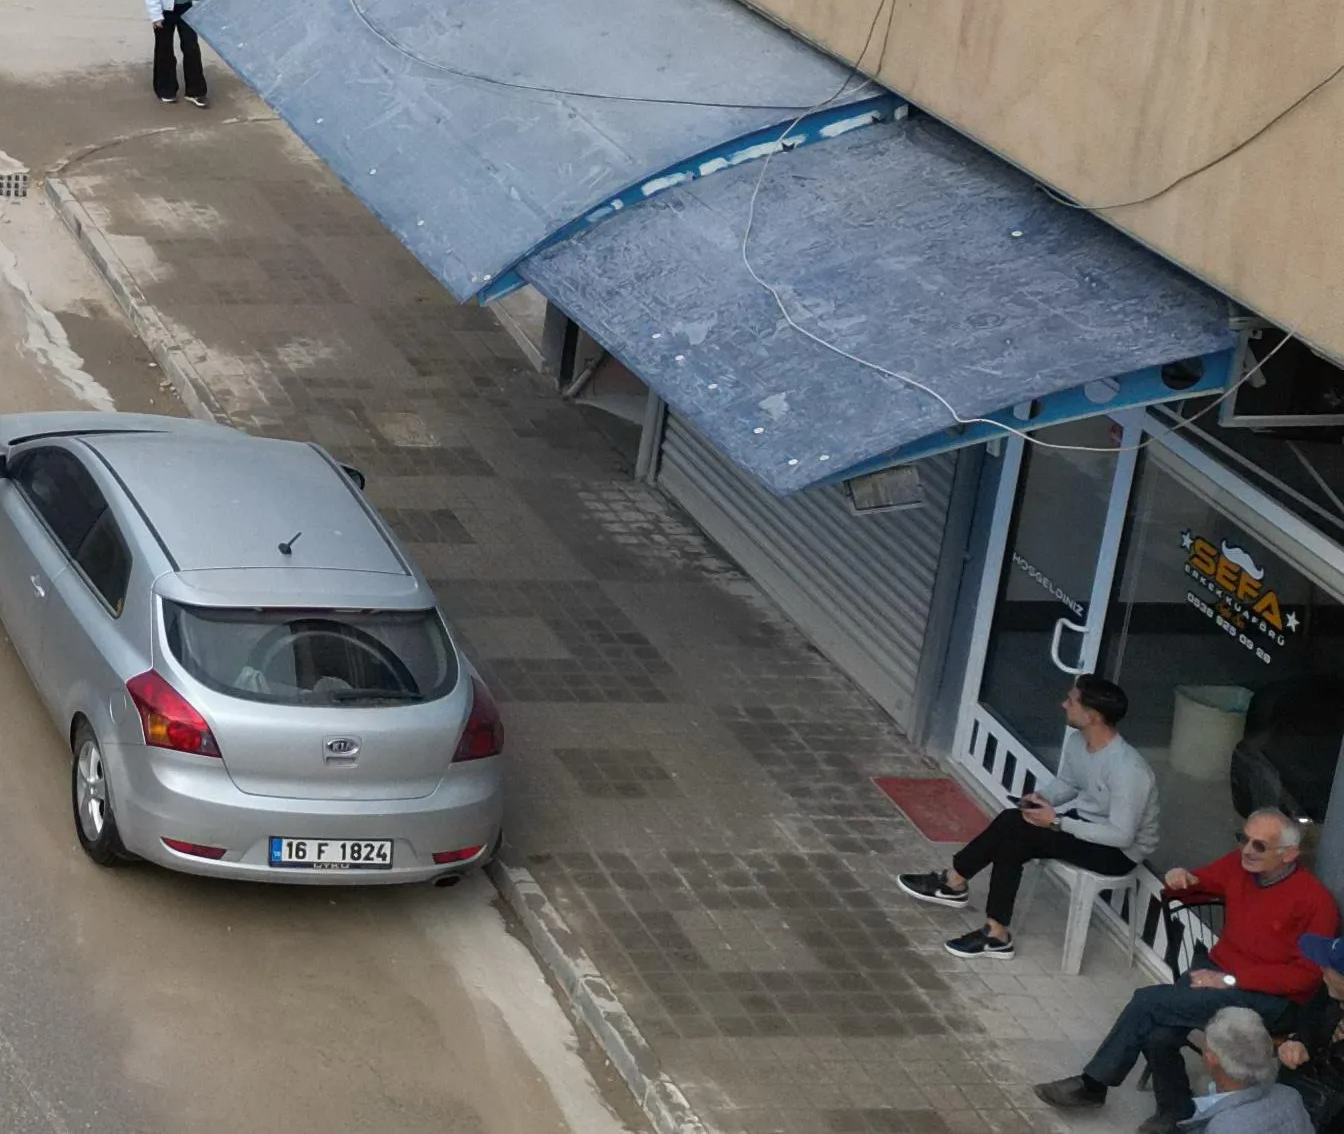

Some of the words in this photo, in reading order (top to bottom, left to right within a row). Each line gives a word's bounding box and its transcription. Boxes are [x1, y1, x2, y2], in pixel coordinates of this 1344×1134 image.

[1190, 537, 1283, 631] SEFA
[286, 841, 307, 860] 16
[317, 842, 329, 860] F
[340, 842, 388, 861] 1824
